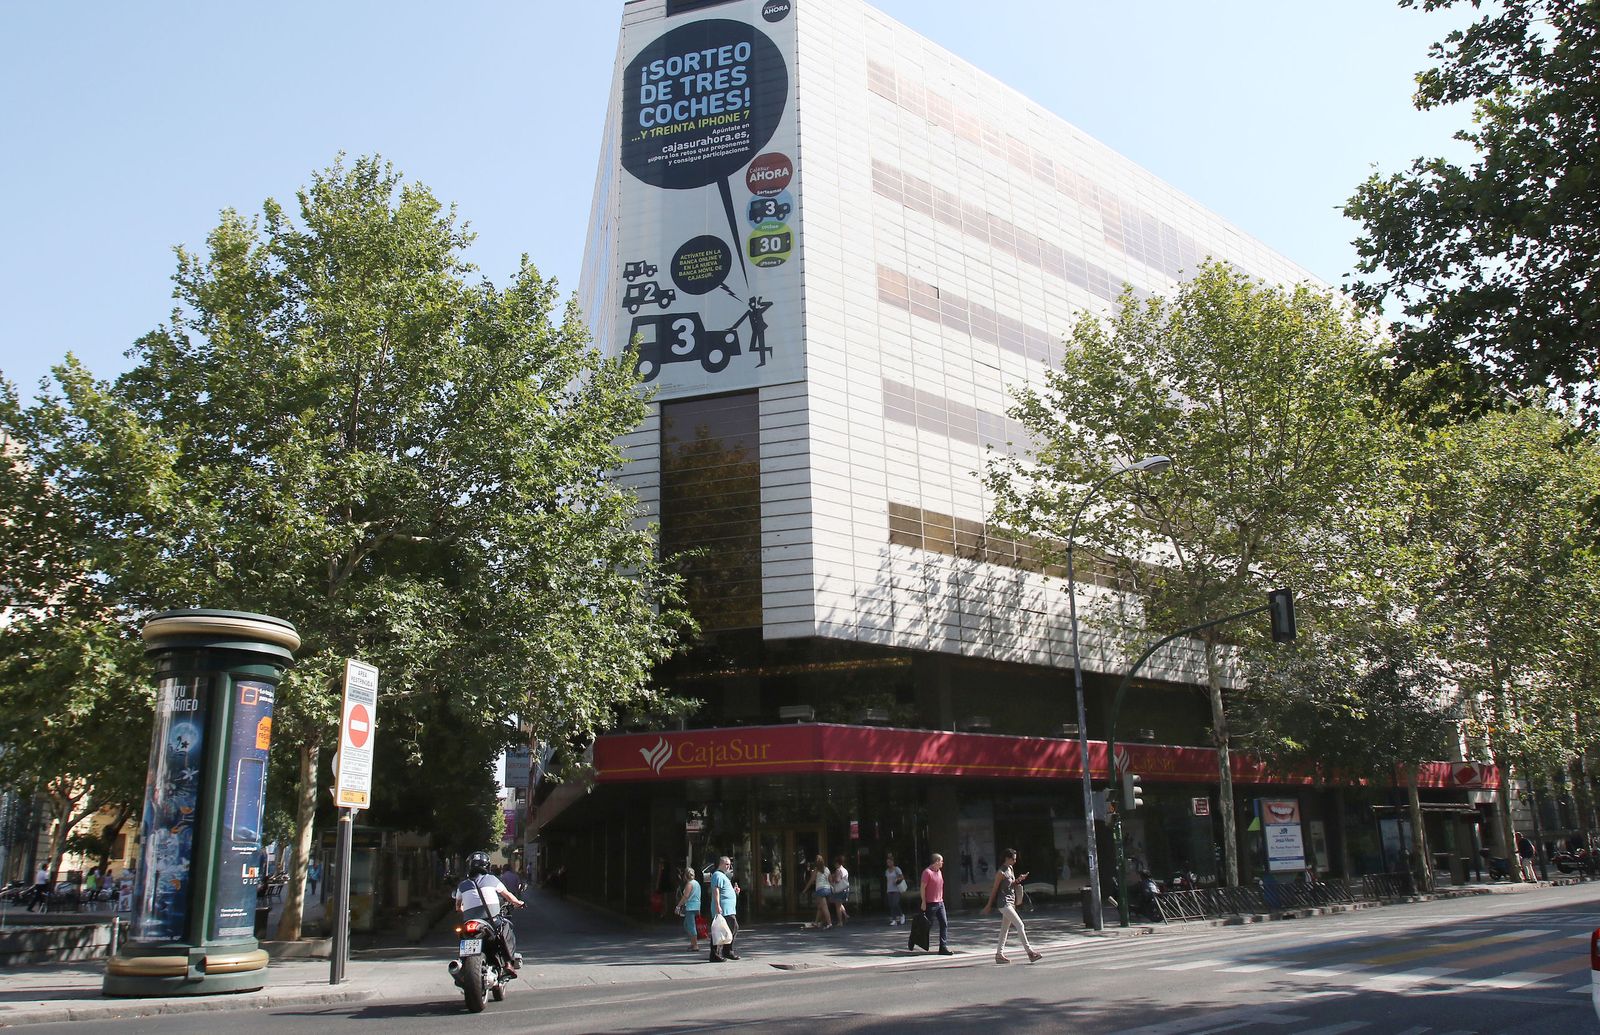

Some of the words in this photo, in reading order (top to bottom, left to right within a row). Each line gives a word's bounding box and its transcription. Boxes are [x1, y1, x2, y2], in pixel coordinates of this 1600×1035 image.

[764, 5, 788, 15] AHORA
[642, 42, 750, 85] ¡SORTEO
[640, 80, 672, 105] DE
[680, 66, 747, 96] TRES
[639, 87, 750, 128] COCHES!
[650, 121, 696, 138] TREINTA
[698, 112, 740, 128] IPHONE
[743, 110, 750, 120] 7
[712, 125, 740, 135] Apúntate
[662, 130, 750, 153] cajasurahora.es,
[648, 154, 669, 163] supera
[680, 149, 696, 157] retos
[710, 140, 750, 152] proponemos
[673, 155, 701, 165] consigue
[749, 167, 789, 182] AHORA
[765, 201, 776, 215] 3
[760, 237, 781, 253] 30
[639, 263, 644, 273] 1
[698, 255, 717, 263] ONLINE
[644, 283, 655, 301] 2
[671, 318, 696, 355] 3
[677, 739, 771, 768] CajaSur
